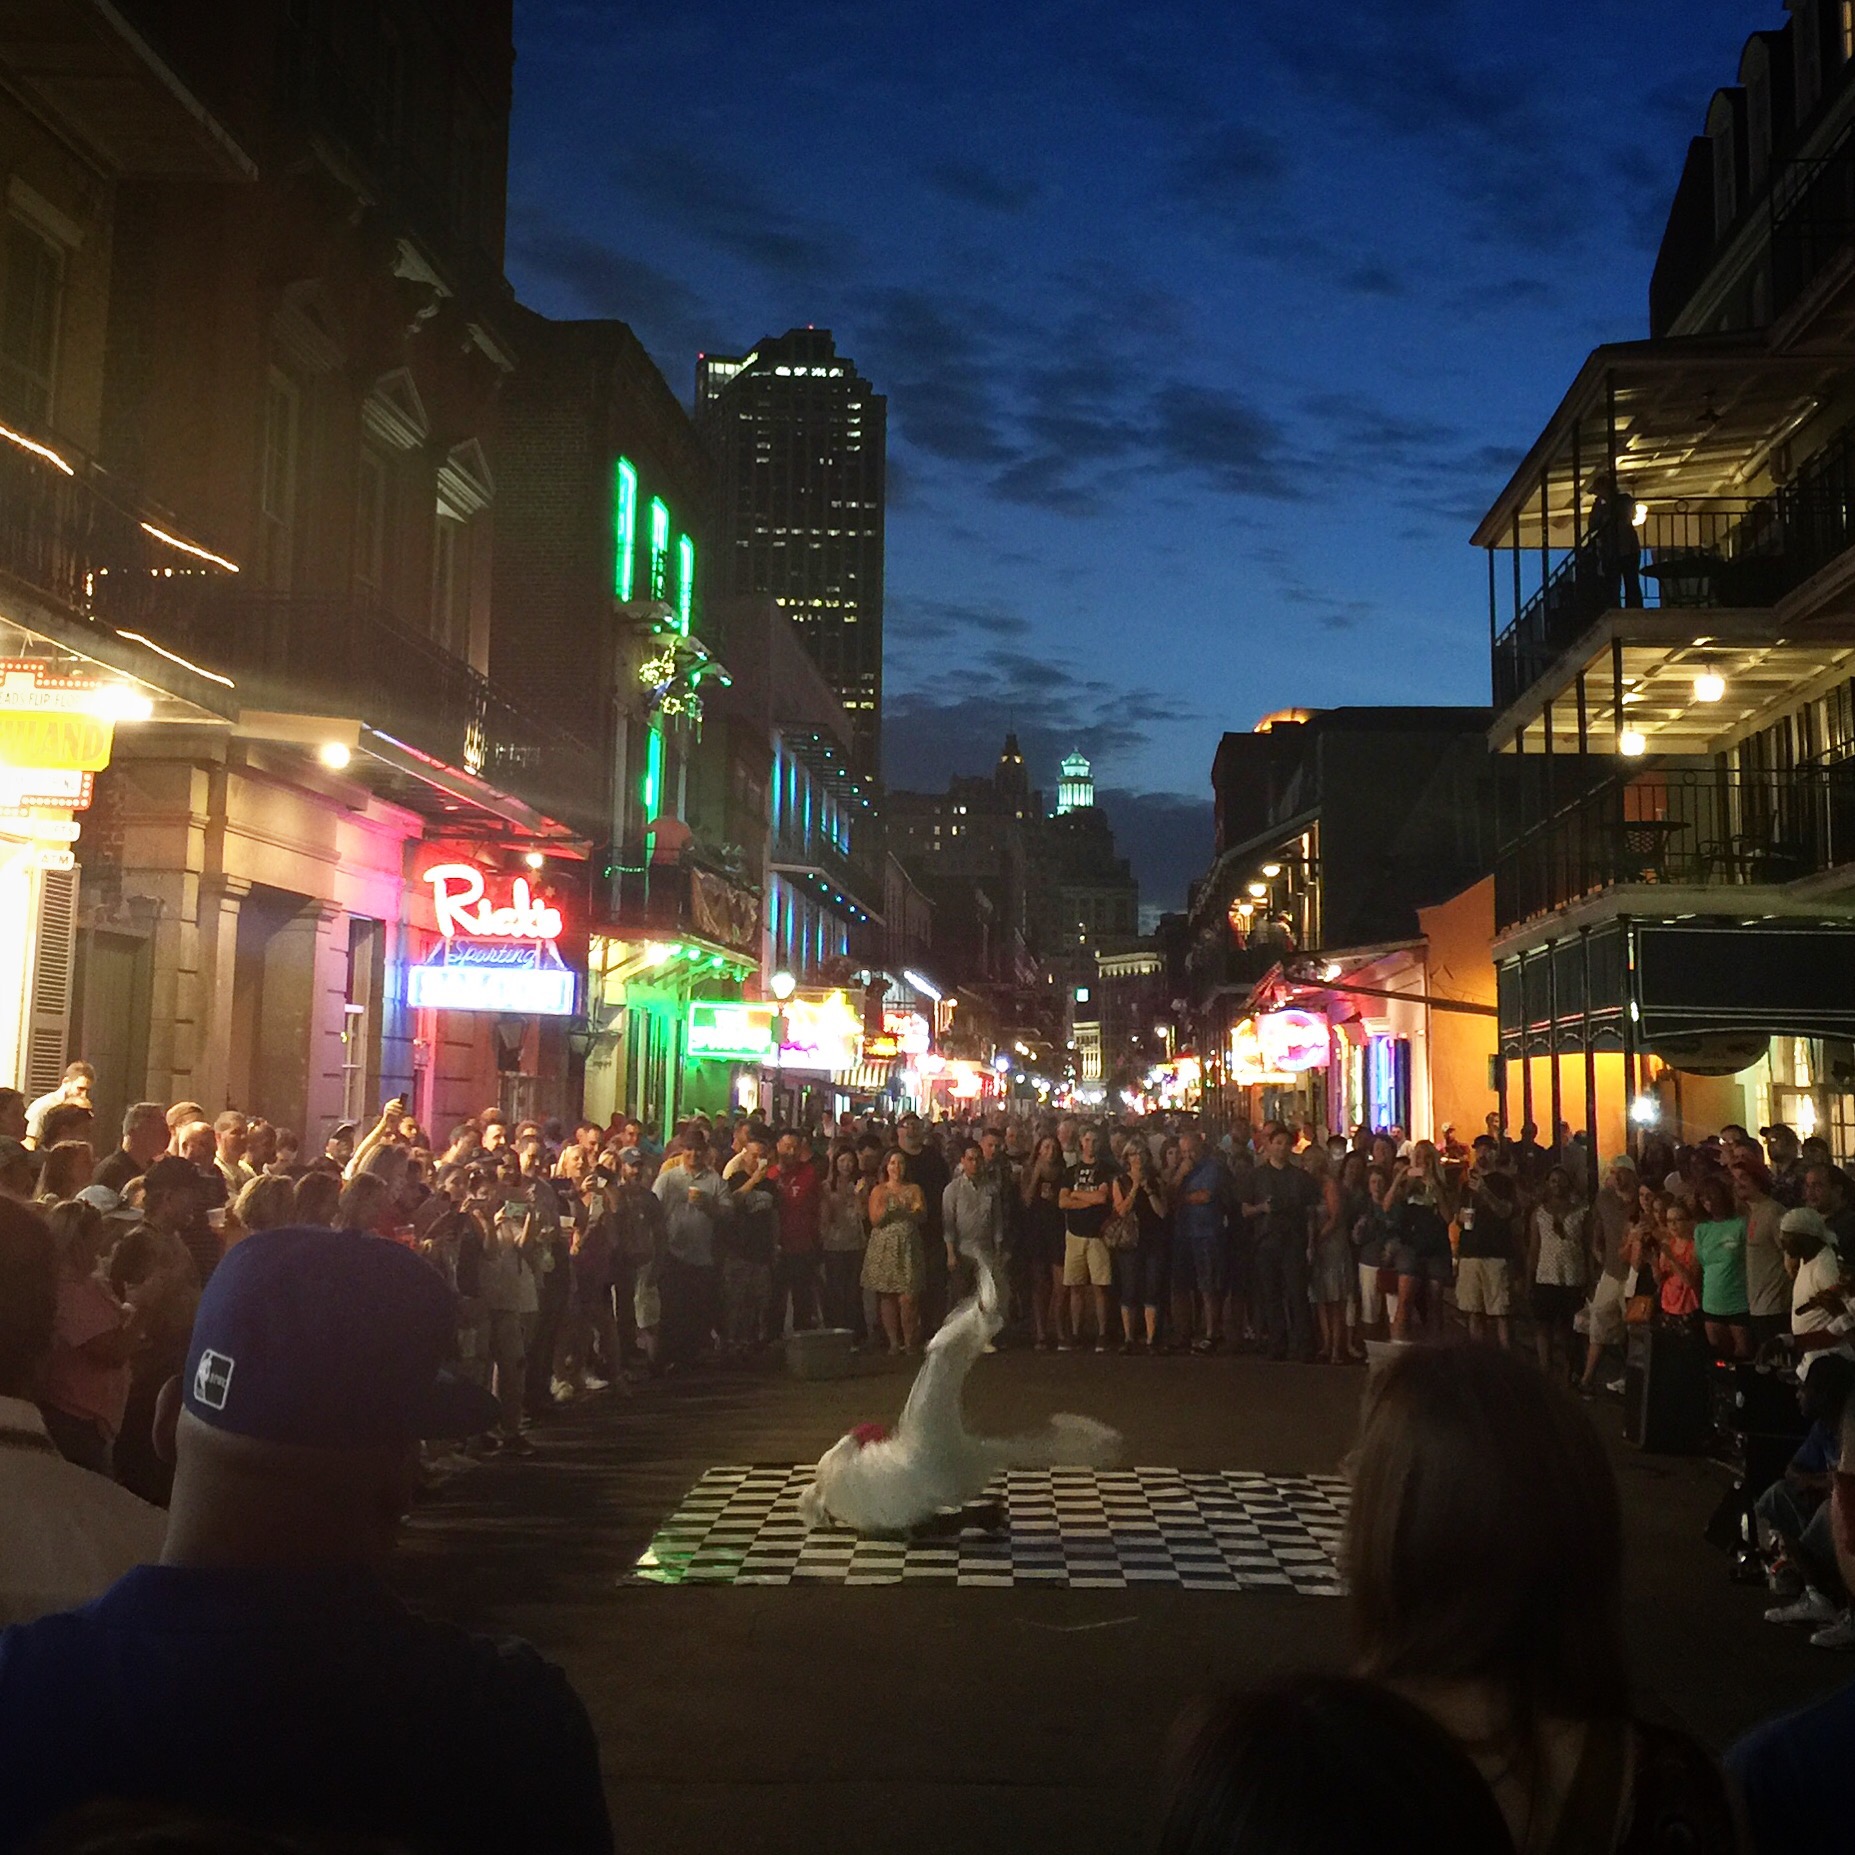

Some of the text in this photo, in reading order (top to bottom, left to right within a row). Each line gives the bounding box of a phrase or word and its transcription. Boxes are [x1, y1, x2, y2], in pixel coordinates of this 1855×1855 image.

[42, 854, 69, 865] ATM
[424, 864, 563, 938] Rick's
[448, 940, 539, 970] Sporting
